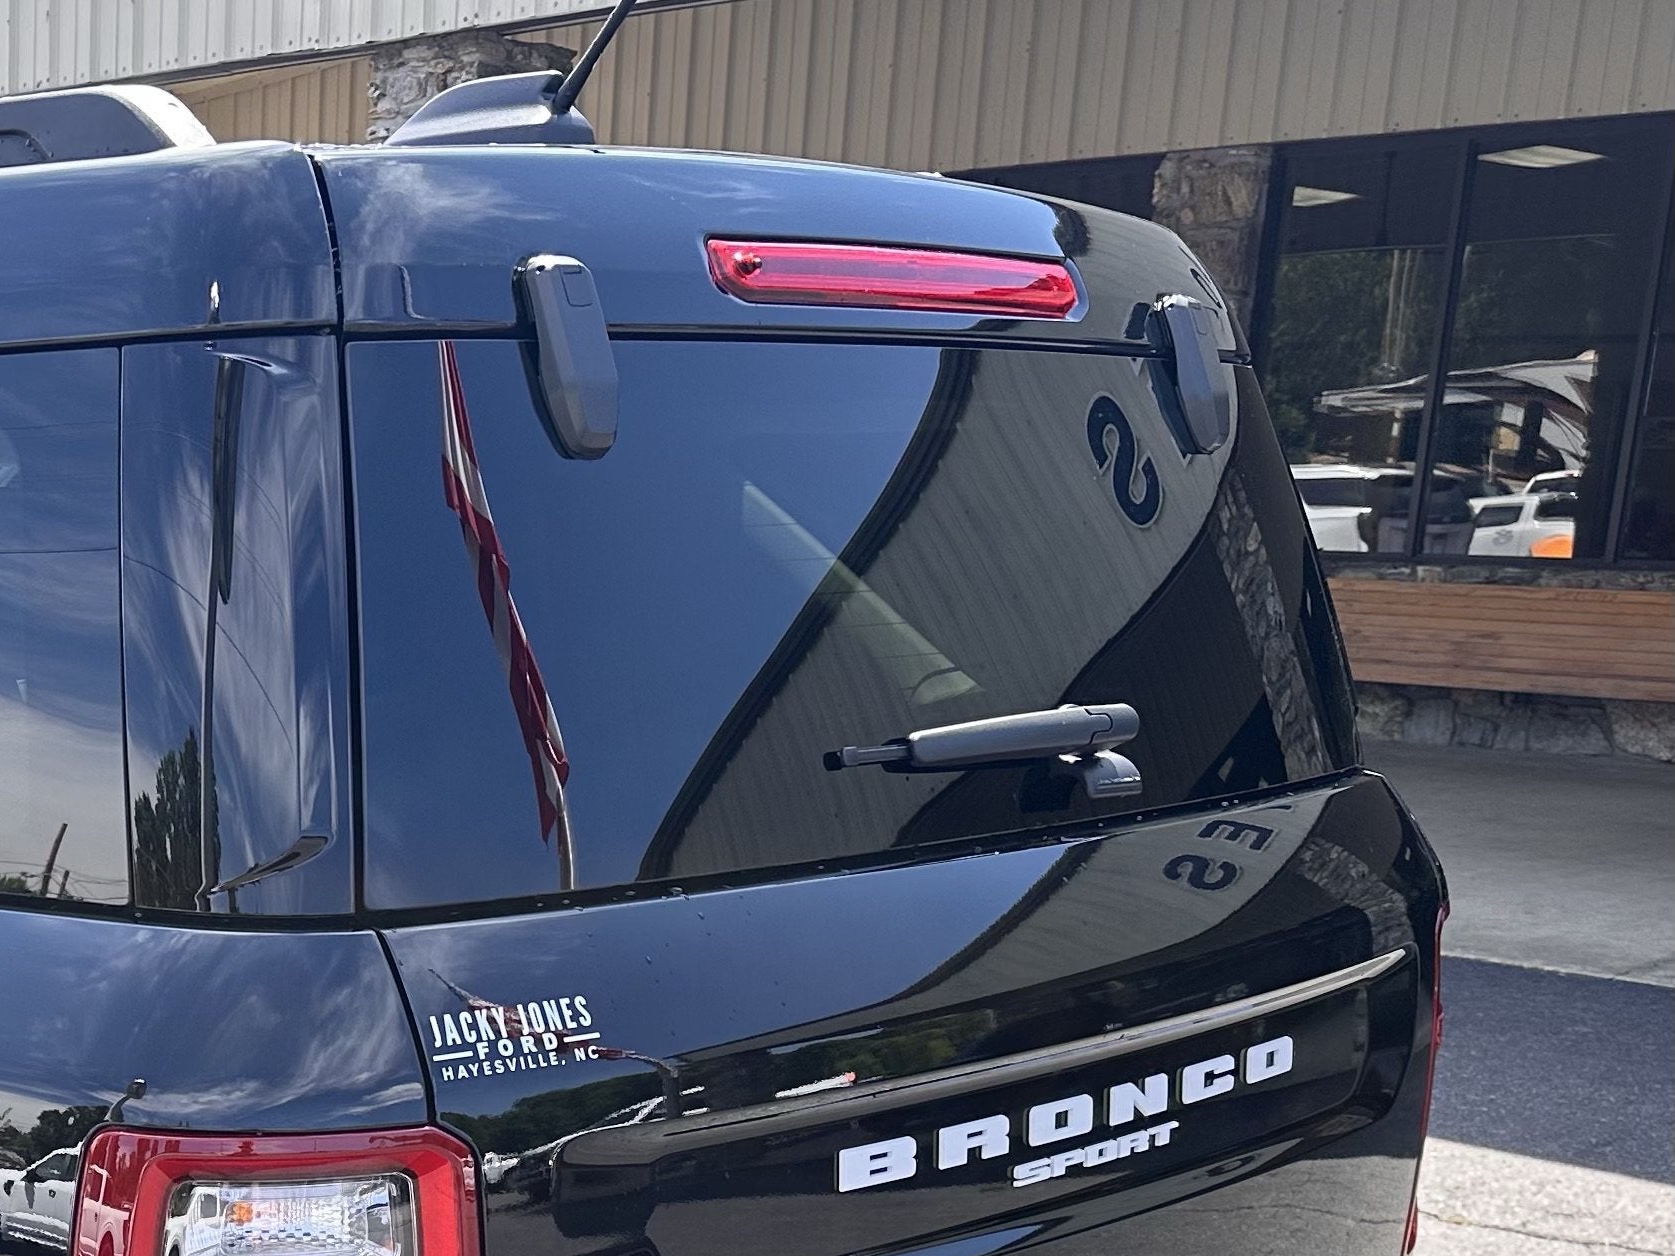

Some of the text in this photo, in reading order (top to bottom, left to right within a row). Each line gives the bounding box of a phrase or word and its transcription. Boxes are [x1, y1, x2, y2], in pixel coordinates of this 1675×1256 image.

[429, 995, 592, 1048] JACKY JONES
[476, 1032, 559, 1060] FORD
[441, 1045, 600, 1082] HAYESVILLE, NC
[834, 1035, 1294, 1194] BRONCO
[1010, 1120, 1180, 1188] SPORT
